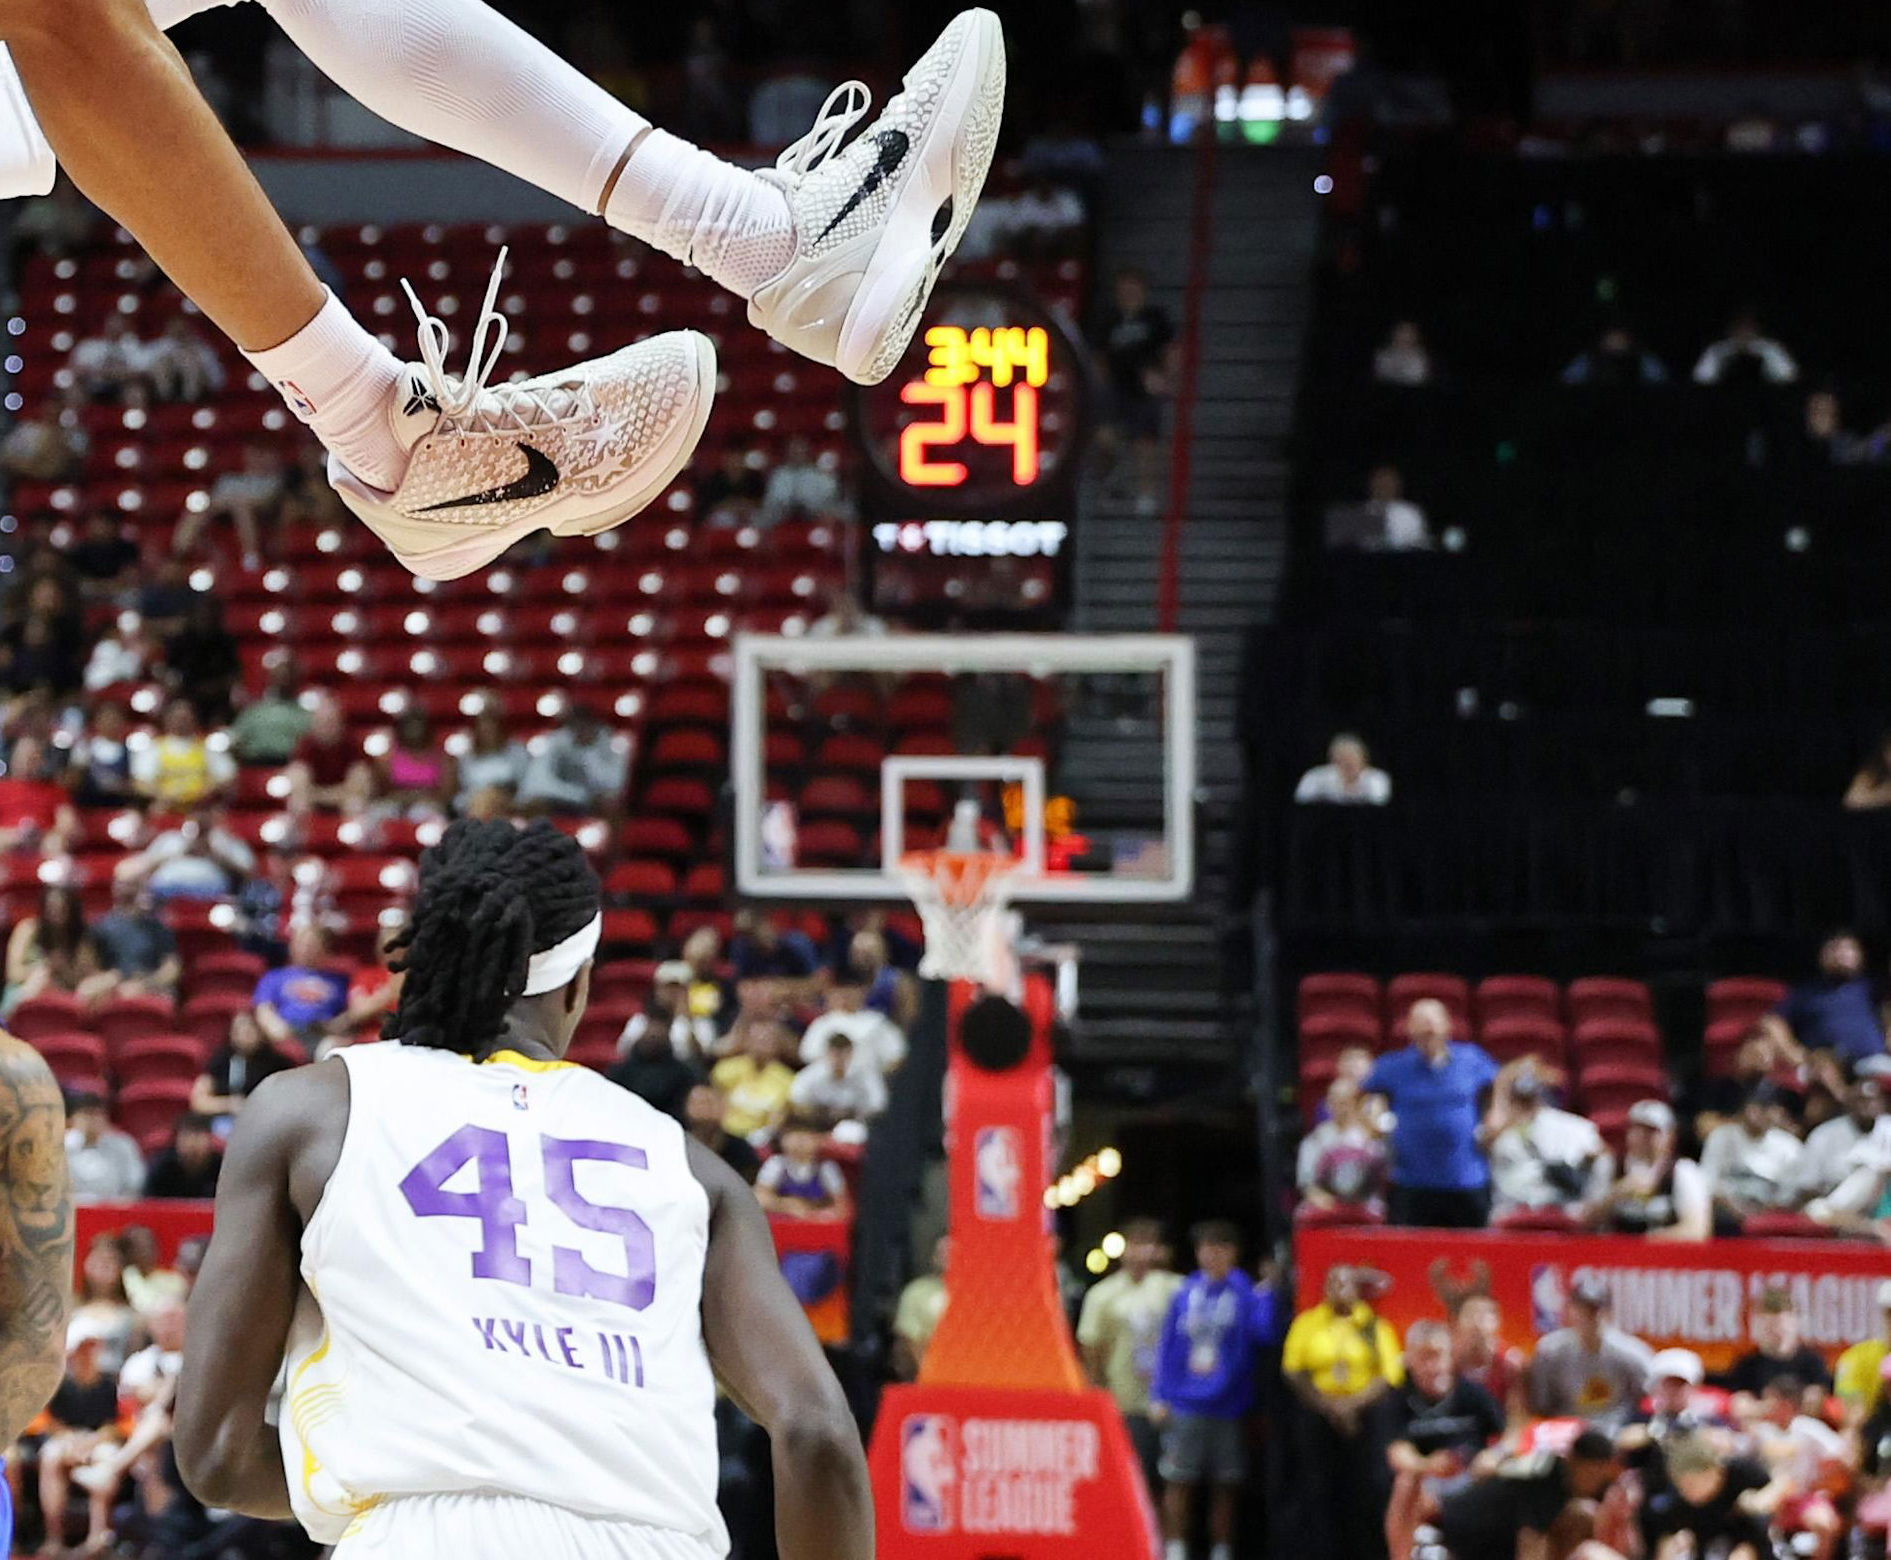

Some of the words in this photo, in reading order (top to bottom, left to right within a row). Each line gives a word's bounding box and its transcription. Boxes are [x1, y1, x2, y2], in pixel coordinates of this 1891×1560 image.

[900, 382, 1040, 484] 24
[398, 1123, 656, 1312] 45
[471, 1316, 585, 1370] KYLE
[597, 1331, 645, 1389] III
[961, 1417, 1101, 1481] SUMMER
[961, 1476, 1078, 1536] LEAGUE
